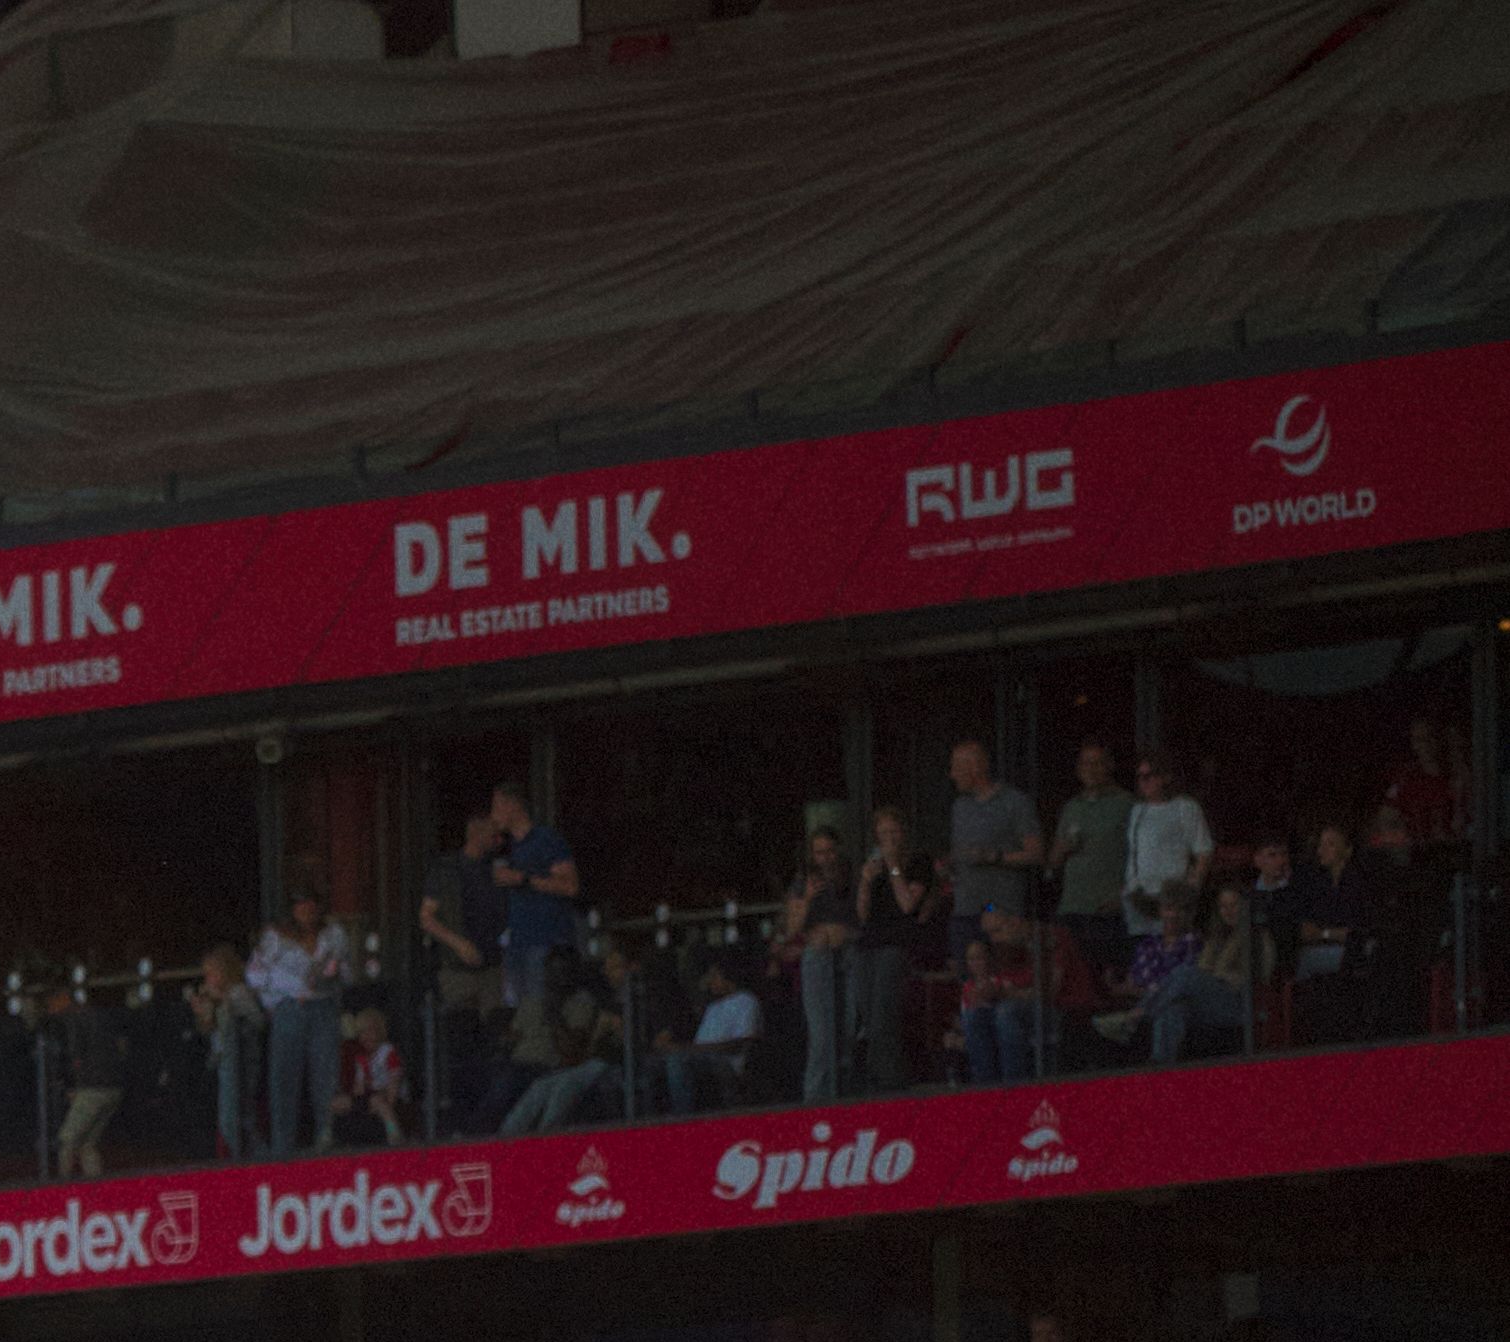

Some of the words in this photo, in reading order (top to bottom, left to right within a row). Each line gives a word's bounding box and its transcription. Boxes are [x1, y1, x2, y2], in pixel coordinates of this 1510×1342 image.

[1232, 501, 1269, 533] DP
[1274, 489, 1377, 526] WORLD
[392, 515, 490, 598] DE
[521, 490, 692, 581] MIK.
[394, 614, 456, 646] REAL
[458, 602, 544, 638] ESTATE
[547, 586, 670, 628] PARTNERS
[2, 656, 121, 702] PARTNERS
[713, 1123, 917, 1208] Spido
[1006, 1151, 1080, 1182] Spido
[238, 1168, 443, 1258] Jordex
